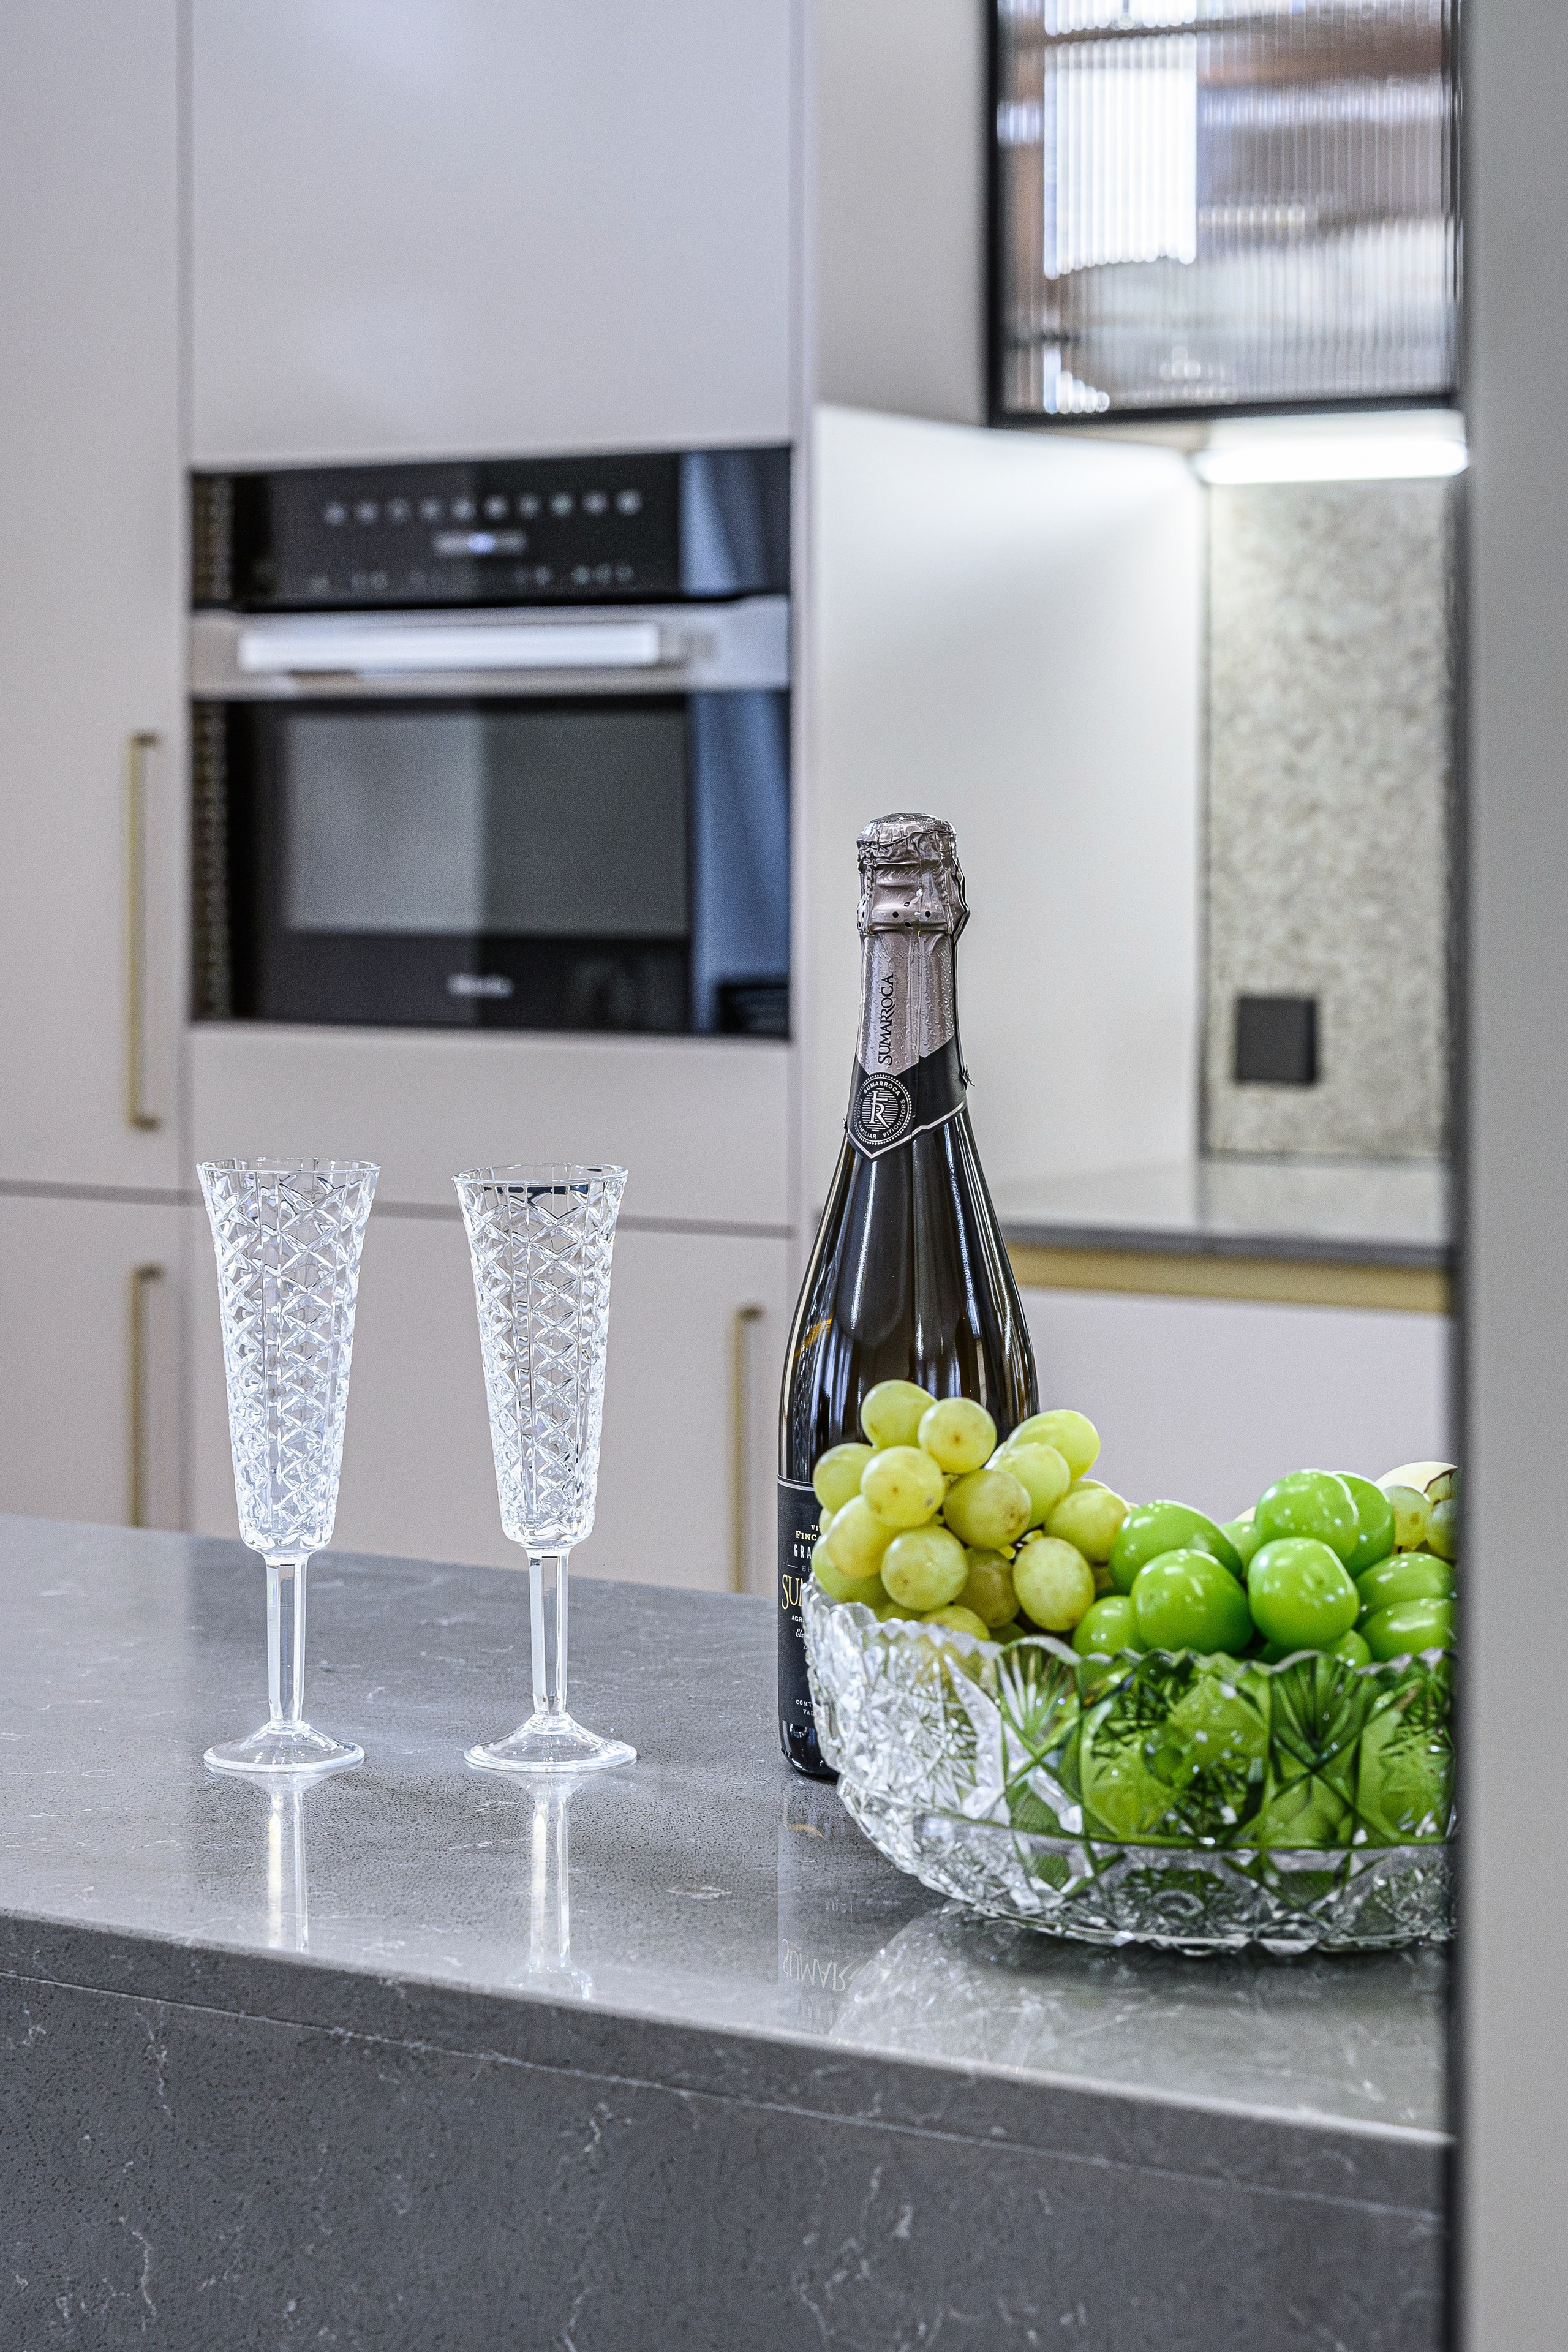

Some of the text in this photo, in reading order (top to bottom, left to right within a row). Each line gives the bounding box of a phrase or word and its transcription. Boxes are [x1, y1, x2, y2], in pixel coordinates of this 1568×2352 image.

[878, 973, 895, 1066] SUMARROCA
[864, 1080, 900, 1096] SUMARROCA
[883, 1099, 906, 1137] VITICULTORS
